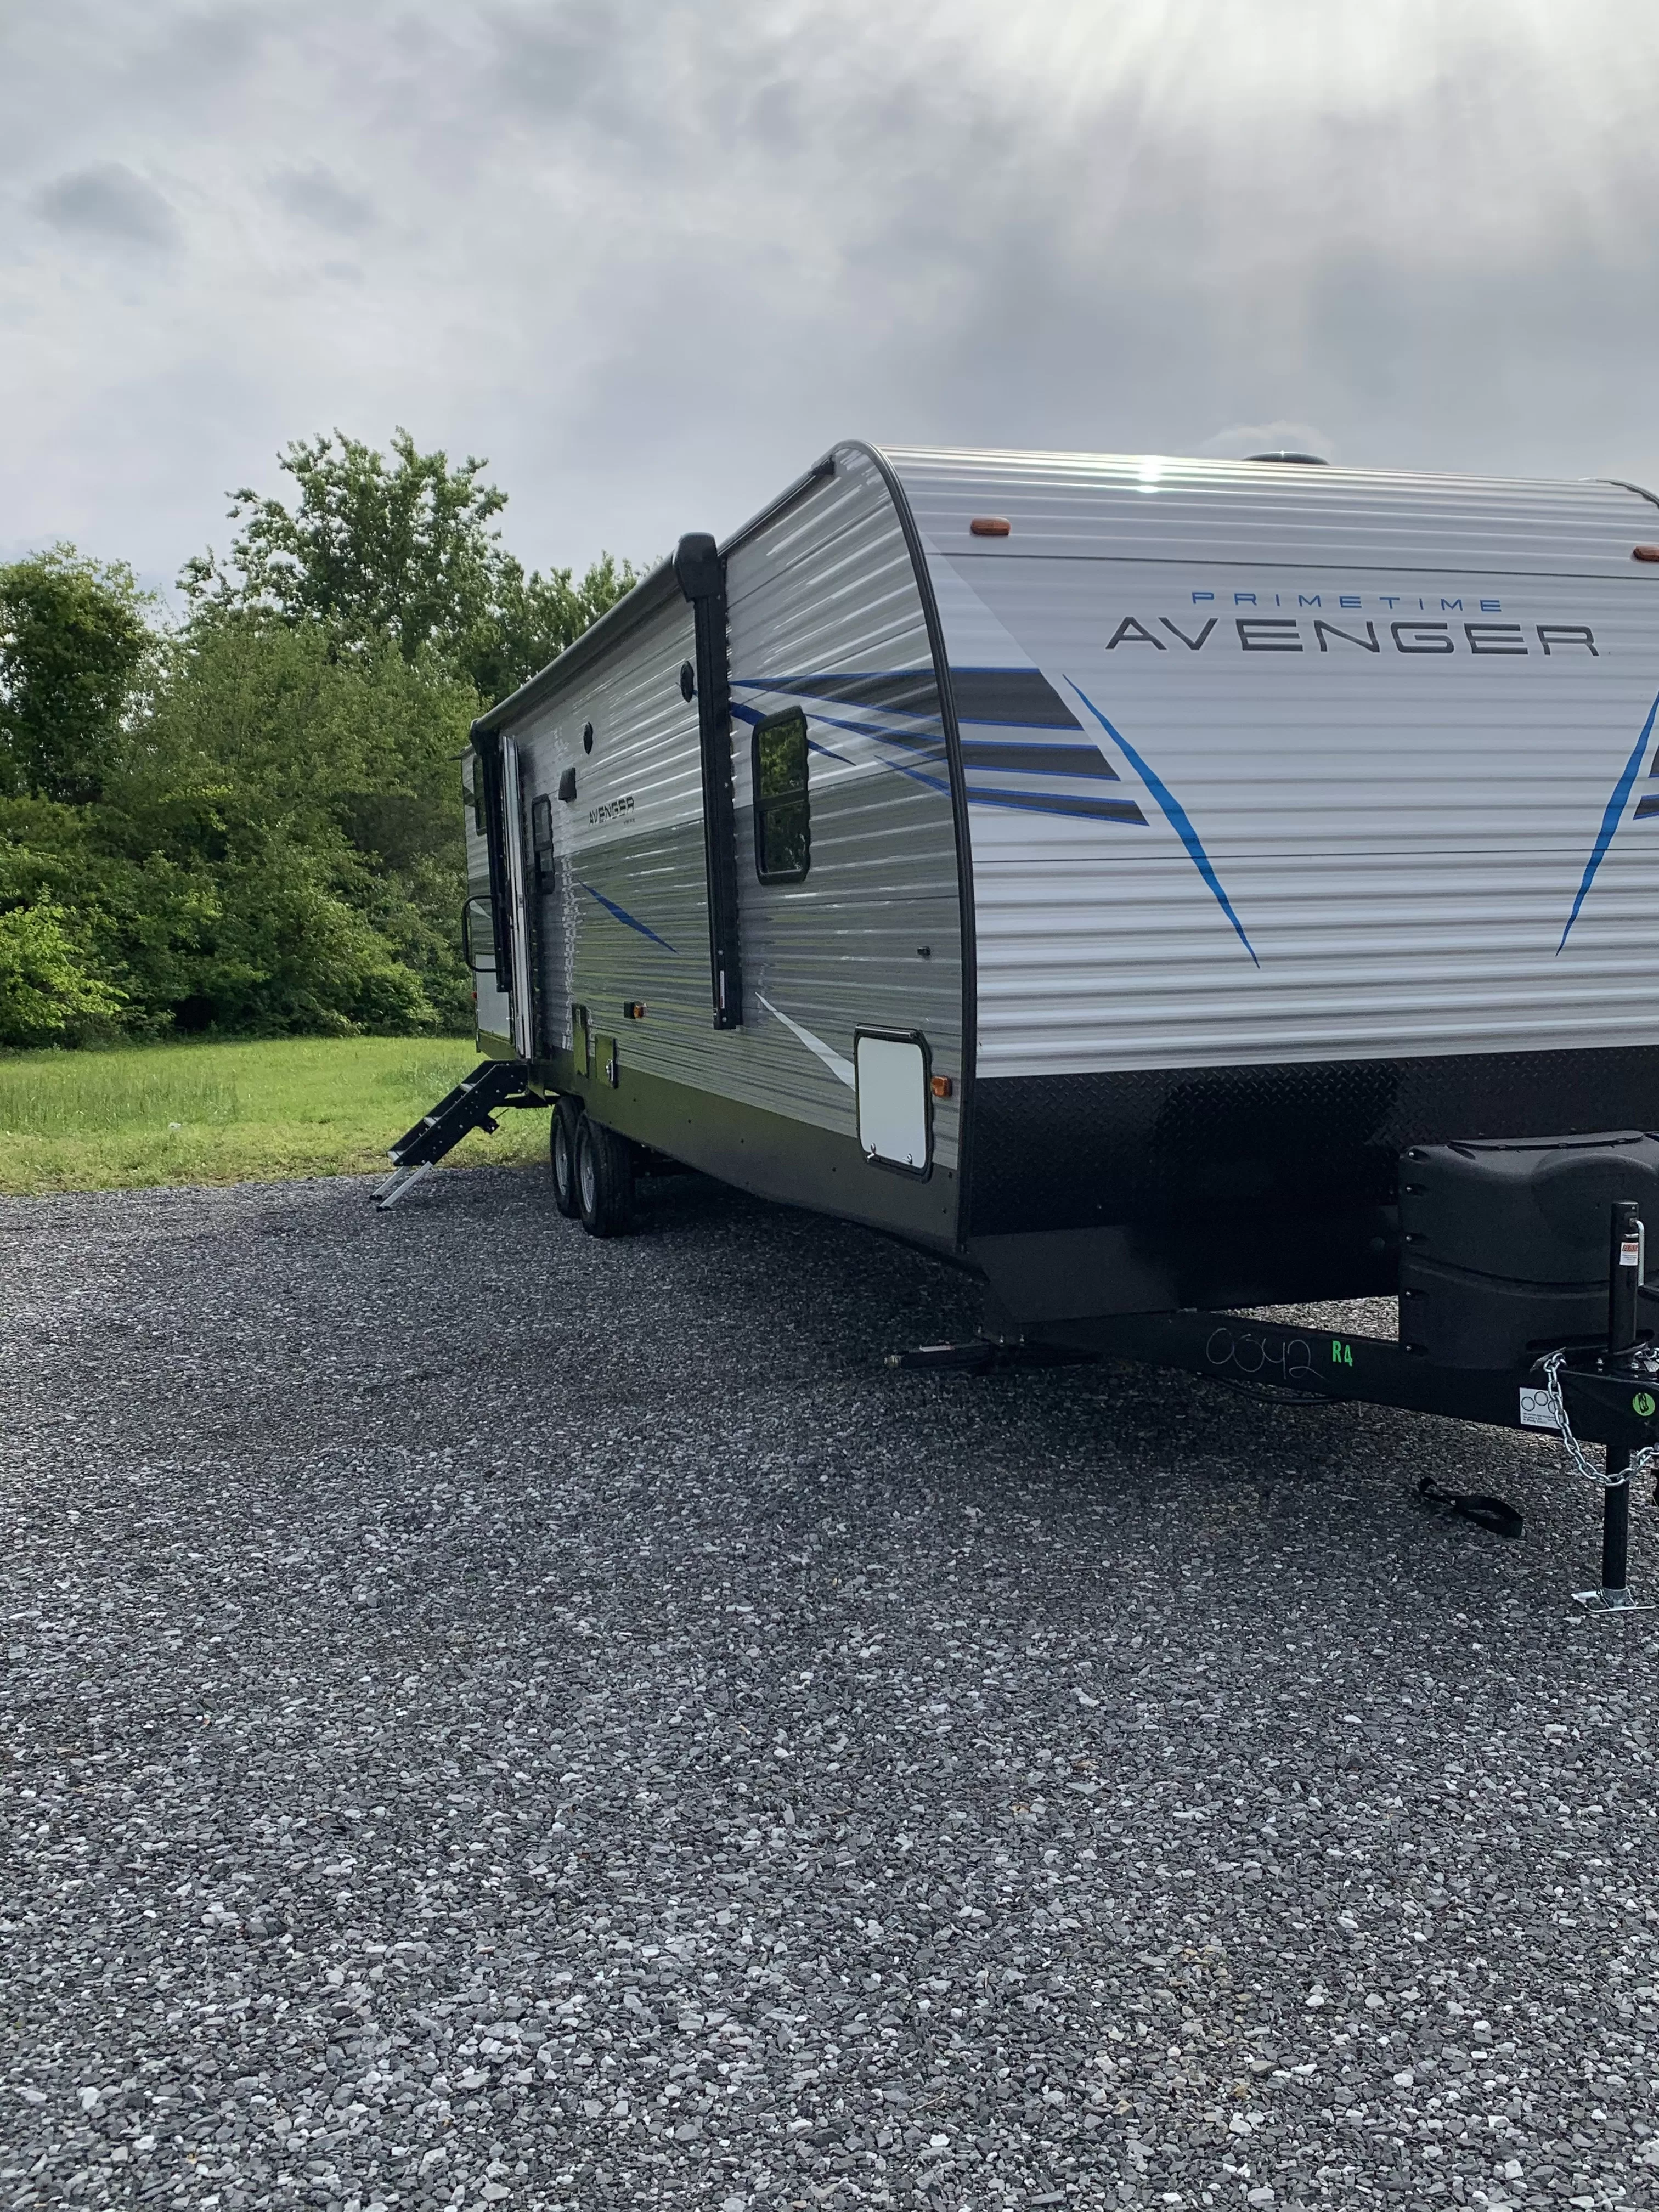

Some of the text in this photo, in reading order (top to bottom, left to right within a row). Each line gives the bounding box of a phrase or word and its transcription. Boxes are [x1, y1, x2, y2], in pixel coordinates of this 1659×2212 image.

[1105, 617, 1600, 657] AVENGER
[589, 797, 634, 824] AVENGER
[1332, 1340, 1353, 1367] R4
